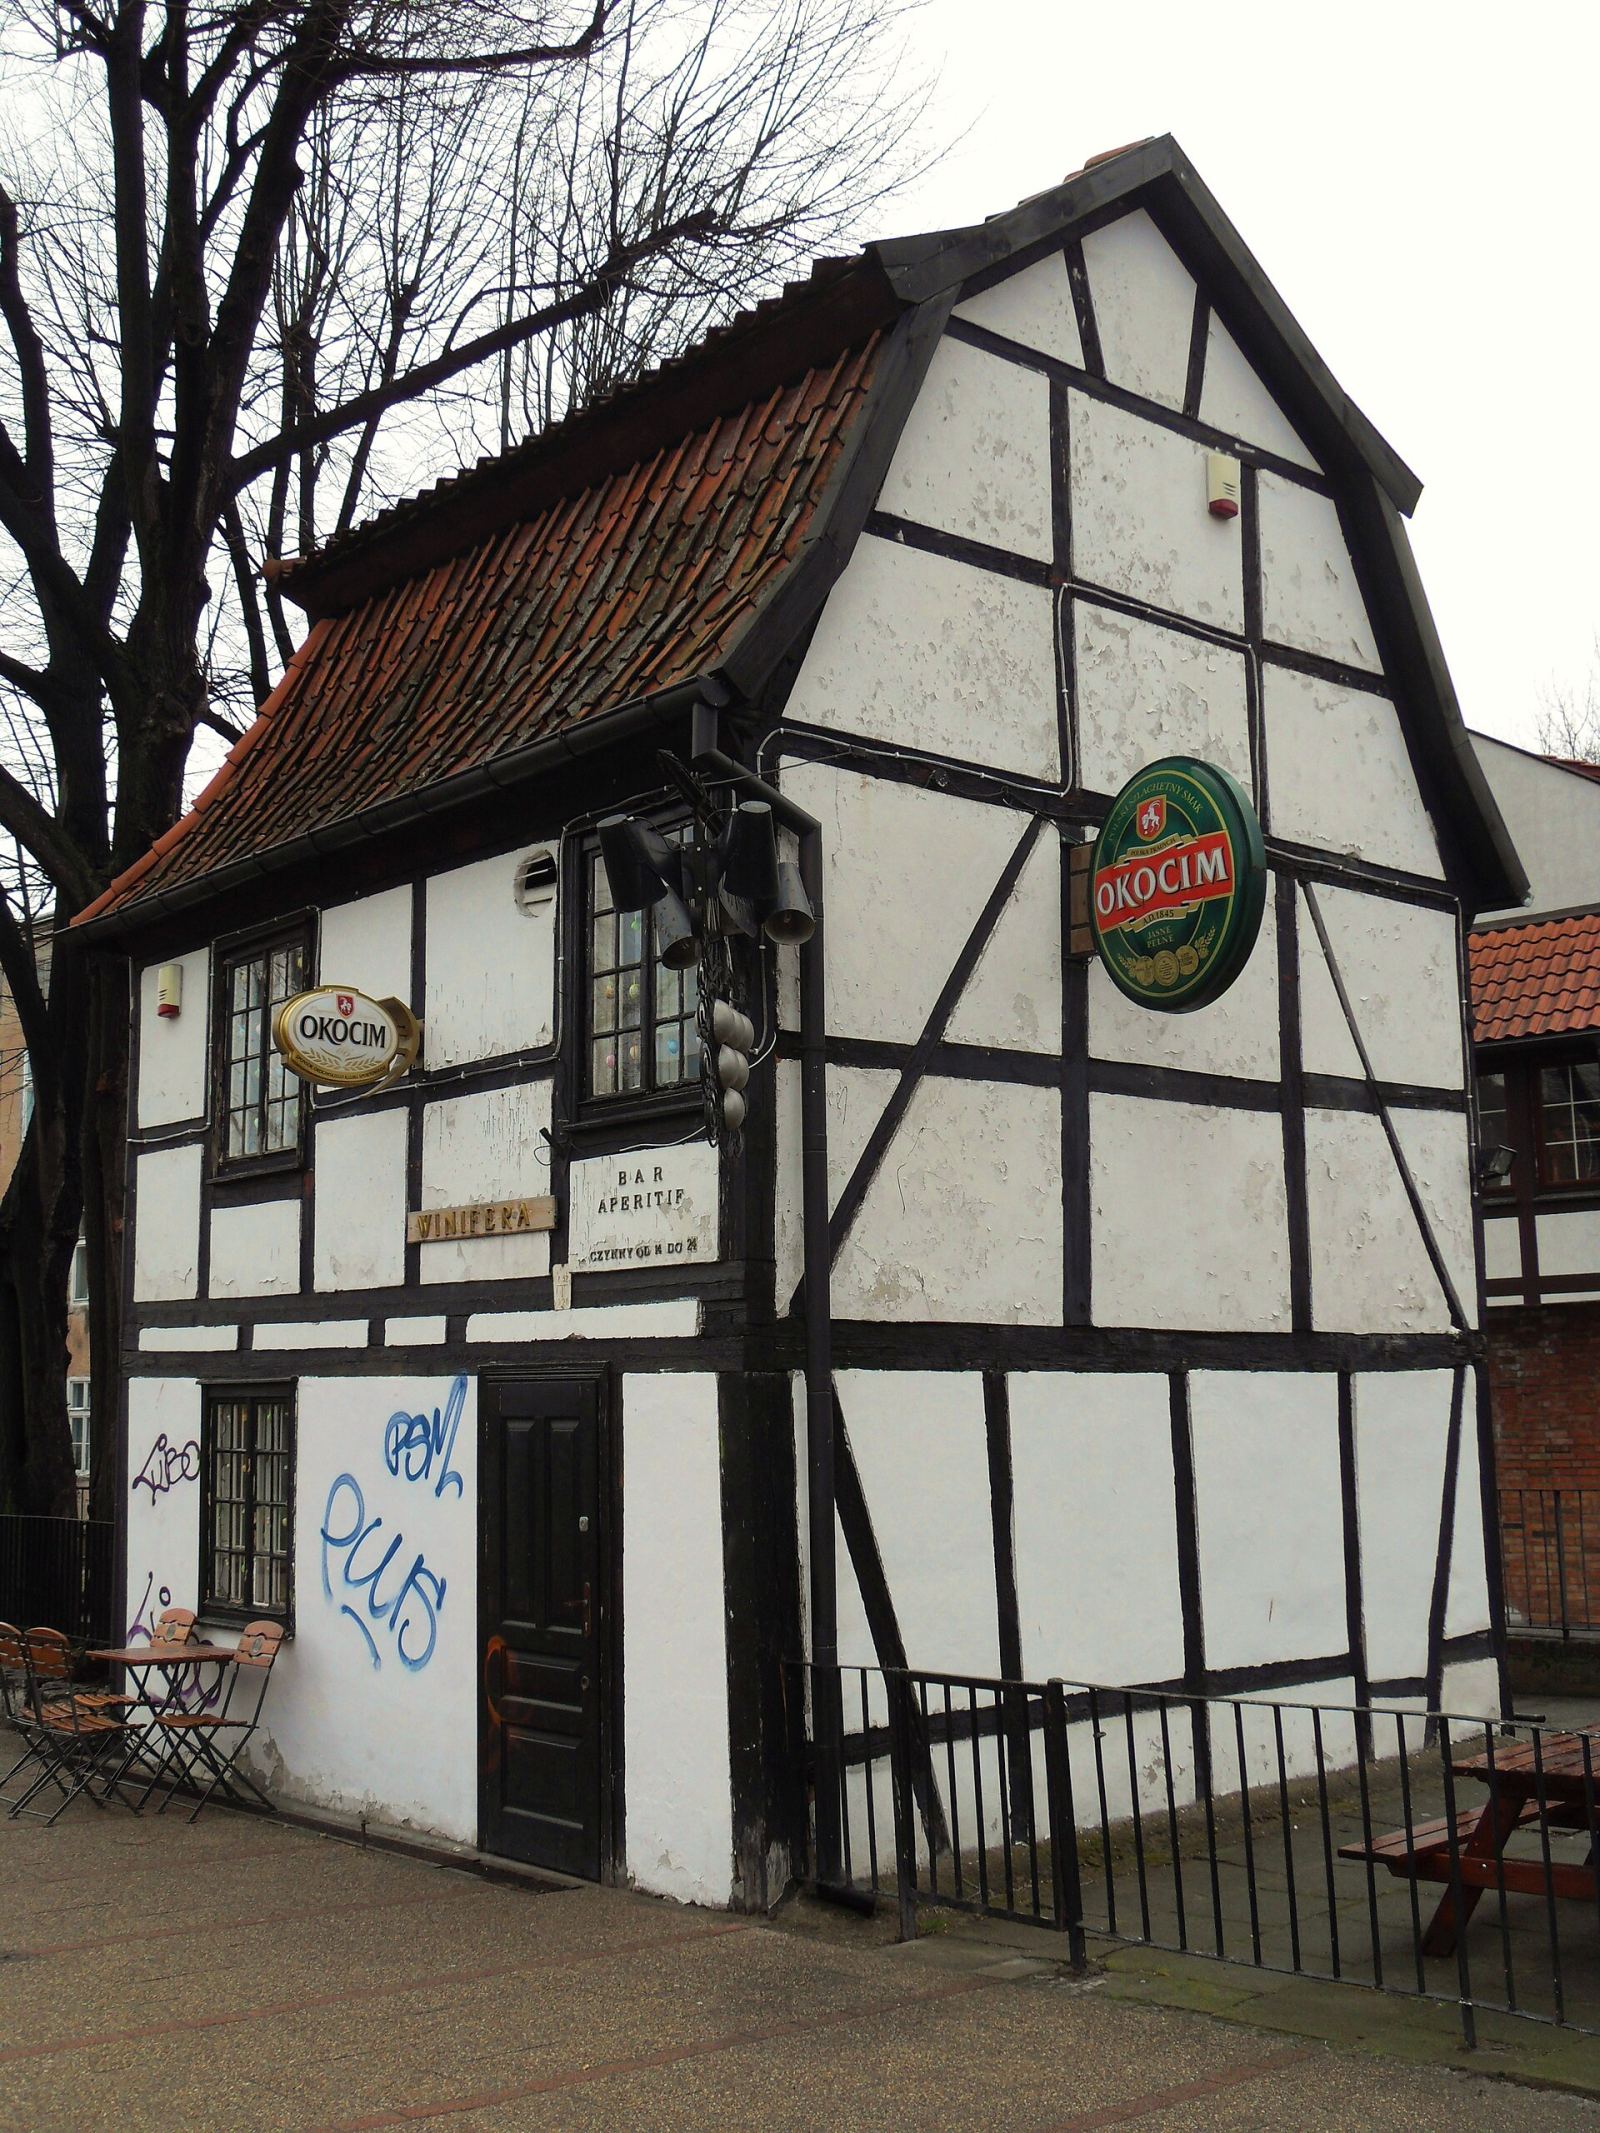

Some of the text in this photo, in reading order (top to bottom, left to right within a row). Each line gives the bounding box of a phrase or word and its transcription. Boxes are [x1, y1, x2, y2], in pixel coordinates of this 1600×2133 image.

[1182, 787, 1203, 815] SMAK
[1097, 846, 1230, 915] OKOCIM
[1147, 926, 1172, 939] JASNE
[300, 1015, 386, 1048] OKOCIM
[618, 1165, 664, 1186] BAR
[598, 1188, 686, 1214] APERITIF
[417, 1201, 531, 1239] WINIFERA
[589, 1247, 634, 1263] CZYNNY
[635, 1245, 651, 1258] OD
[667, 1242, 683, 1254] DO
